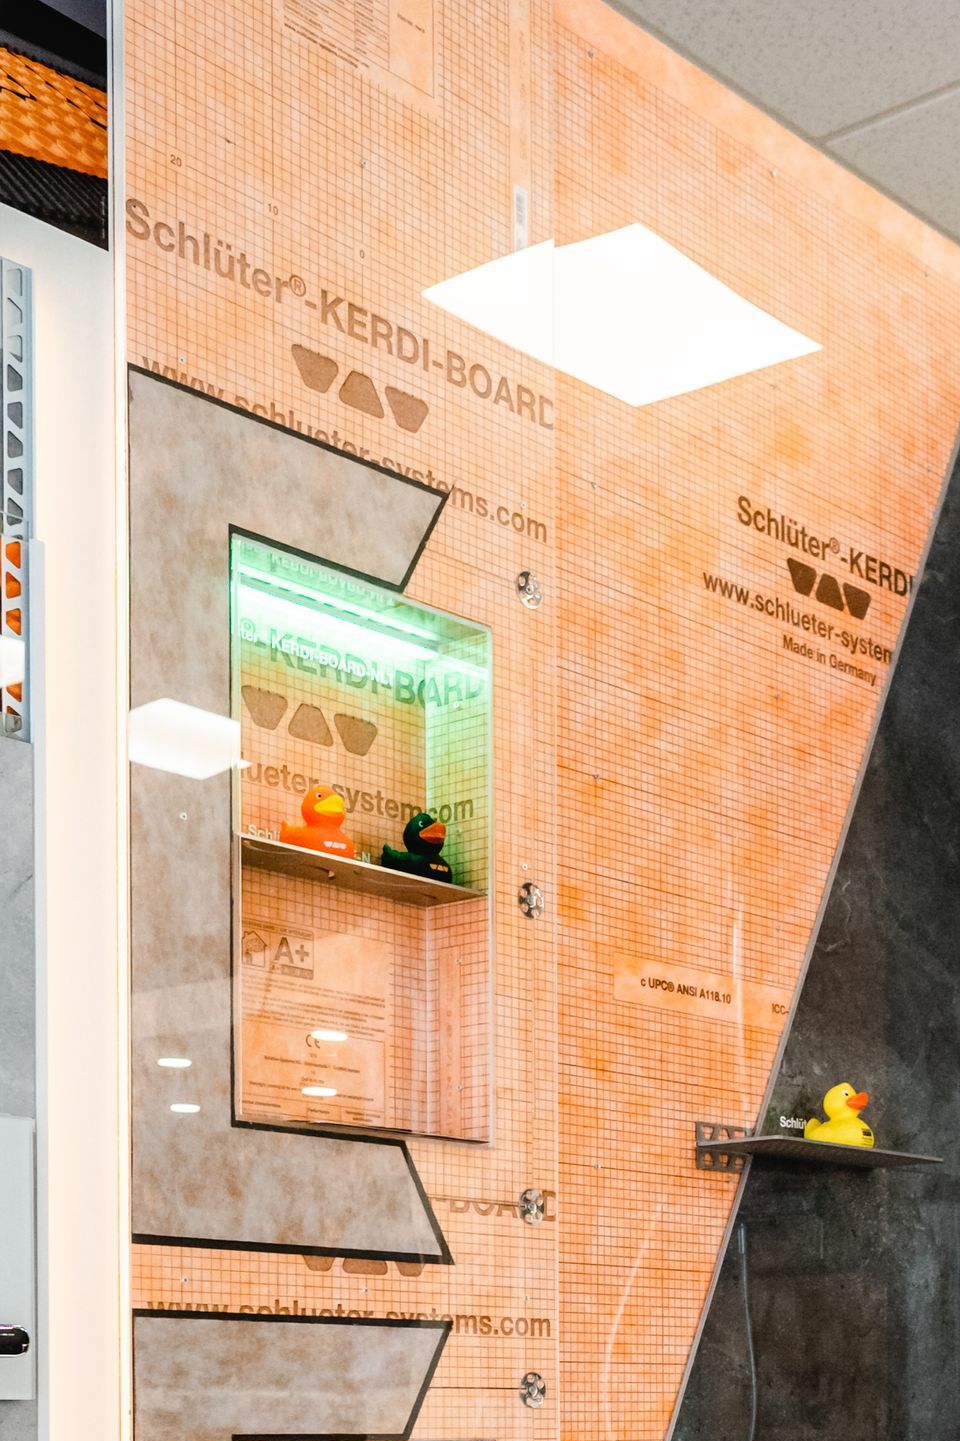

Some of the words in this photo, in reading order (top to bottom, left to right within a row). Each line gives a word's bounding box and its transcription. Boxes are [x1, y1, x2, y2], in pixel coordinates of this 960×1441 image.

[267, 203, 279, 215] 10
[783, 634, 813, 660] Made
[816, 651, 826, 665] in
[829, 653, 877, 687] Germany
[677, 984, 697, 997] ANSI
[700, 988, 731, 1004] A118.10
